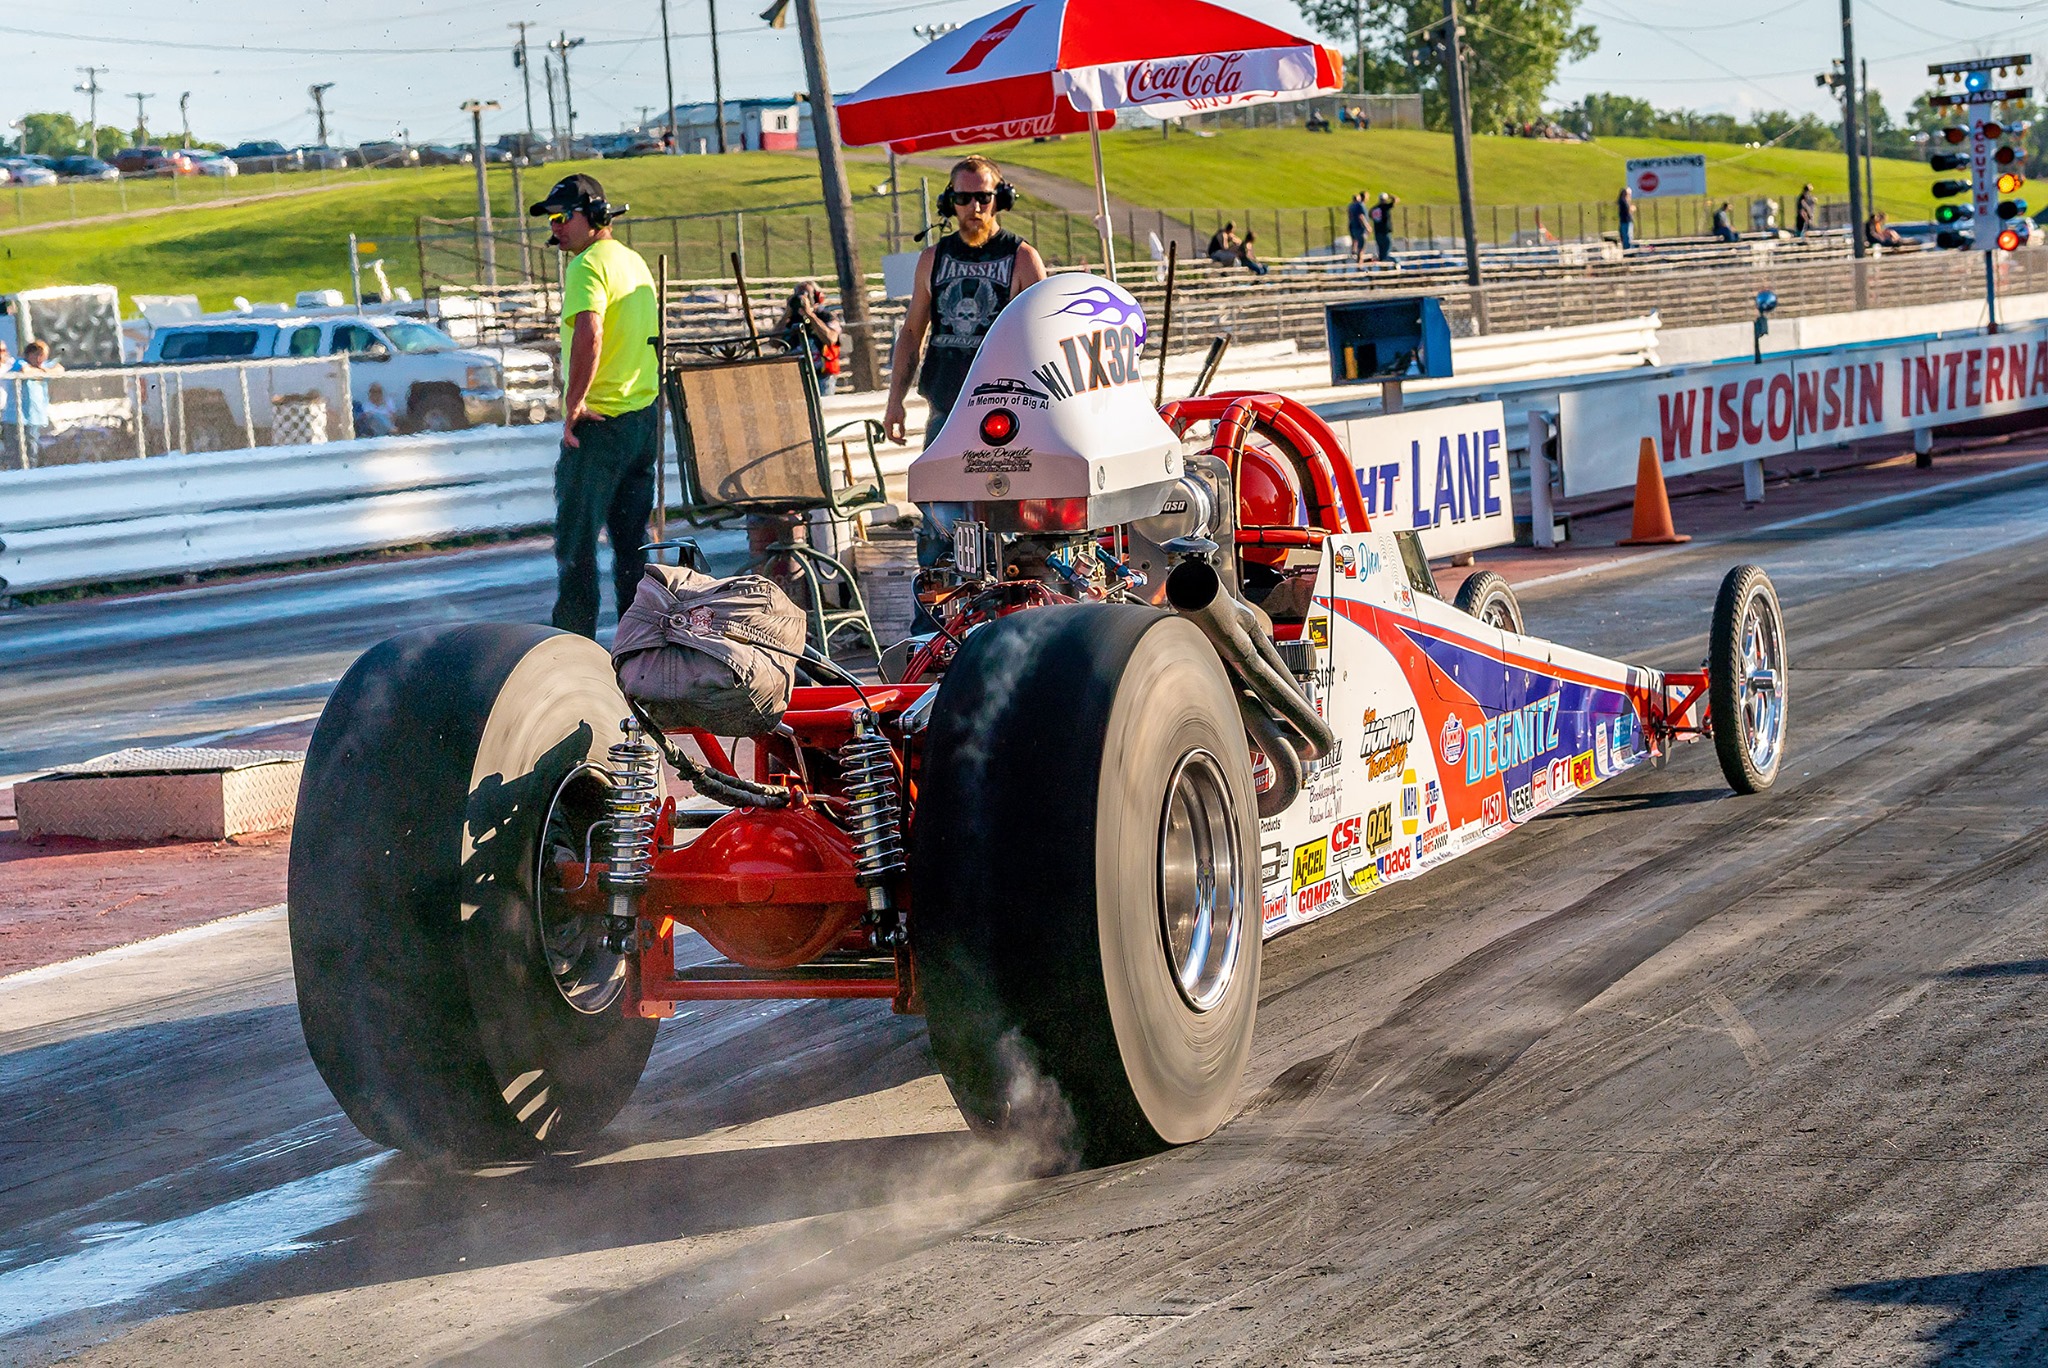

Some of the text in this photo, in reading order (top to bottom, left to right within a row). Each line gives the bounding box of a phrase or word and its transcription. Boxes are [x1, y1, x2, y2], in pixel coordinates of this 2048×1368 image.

[1126, 52, 1245, 103] Coca-Cola
[1950, 90, 2007, 105] STAGE
[936, 257, 1011, 284] JANSSEN
[1031, 361, 1073, 401] WI
[976, 396, 1008, 406] Memory
[1012, 396, 1020, 405] of
[1022, 397, 1037, 409] Big
[1039, 400, 1050, 410] Al
[1658, 341, 2048, 463] WISCONSIN INTERNA
[1412, 429, 1502, 529] LANE
[1466, 691, 1561, 786] DEGNITZ
[1260, 818, 1281, 833] Products
[1483, 794, 1500, 828] MSD
[1298, 880, 1331, 914] COMP
